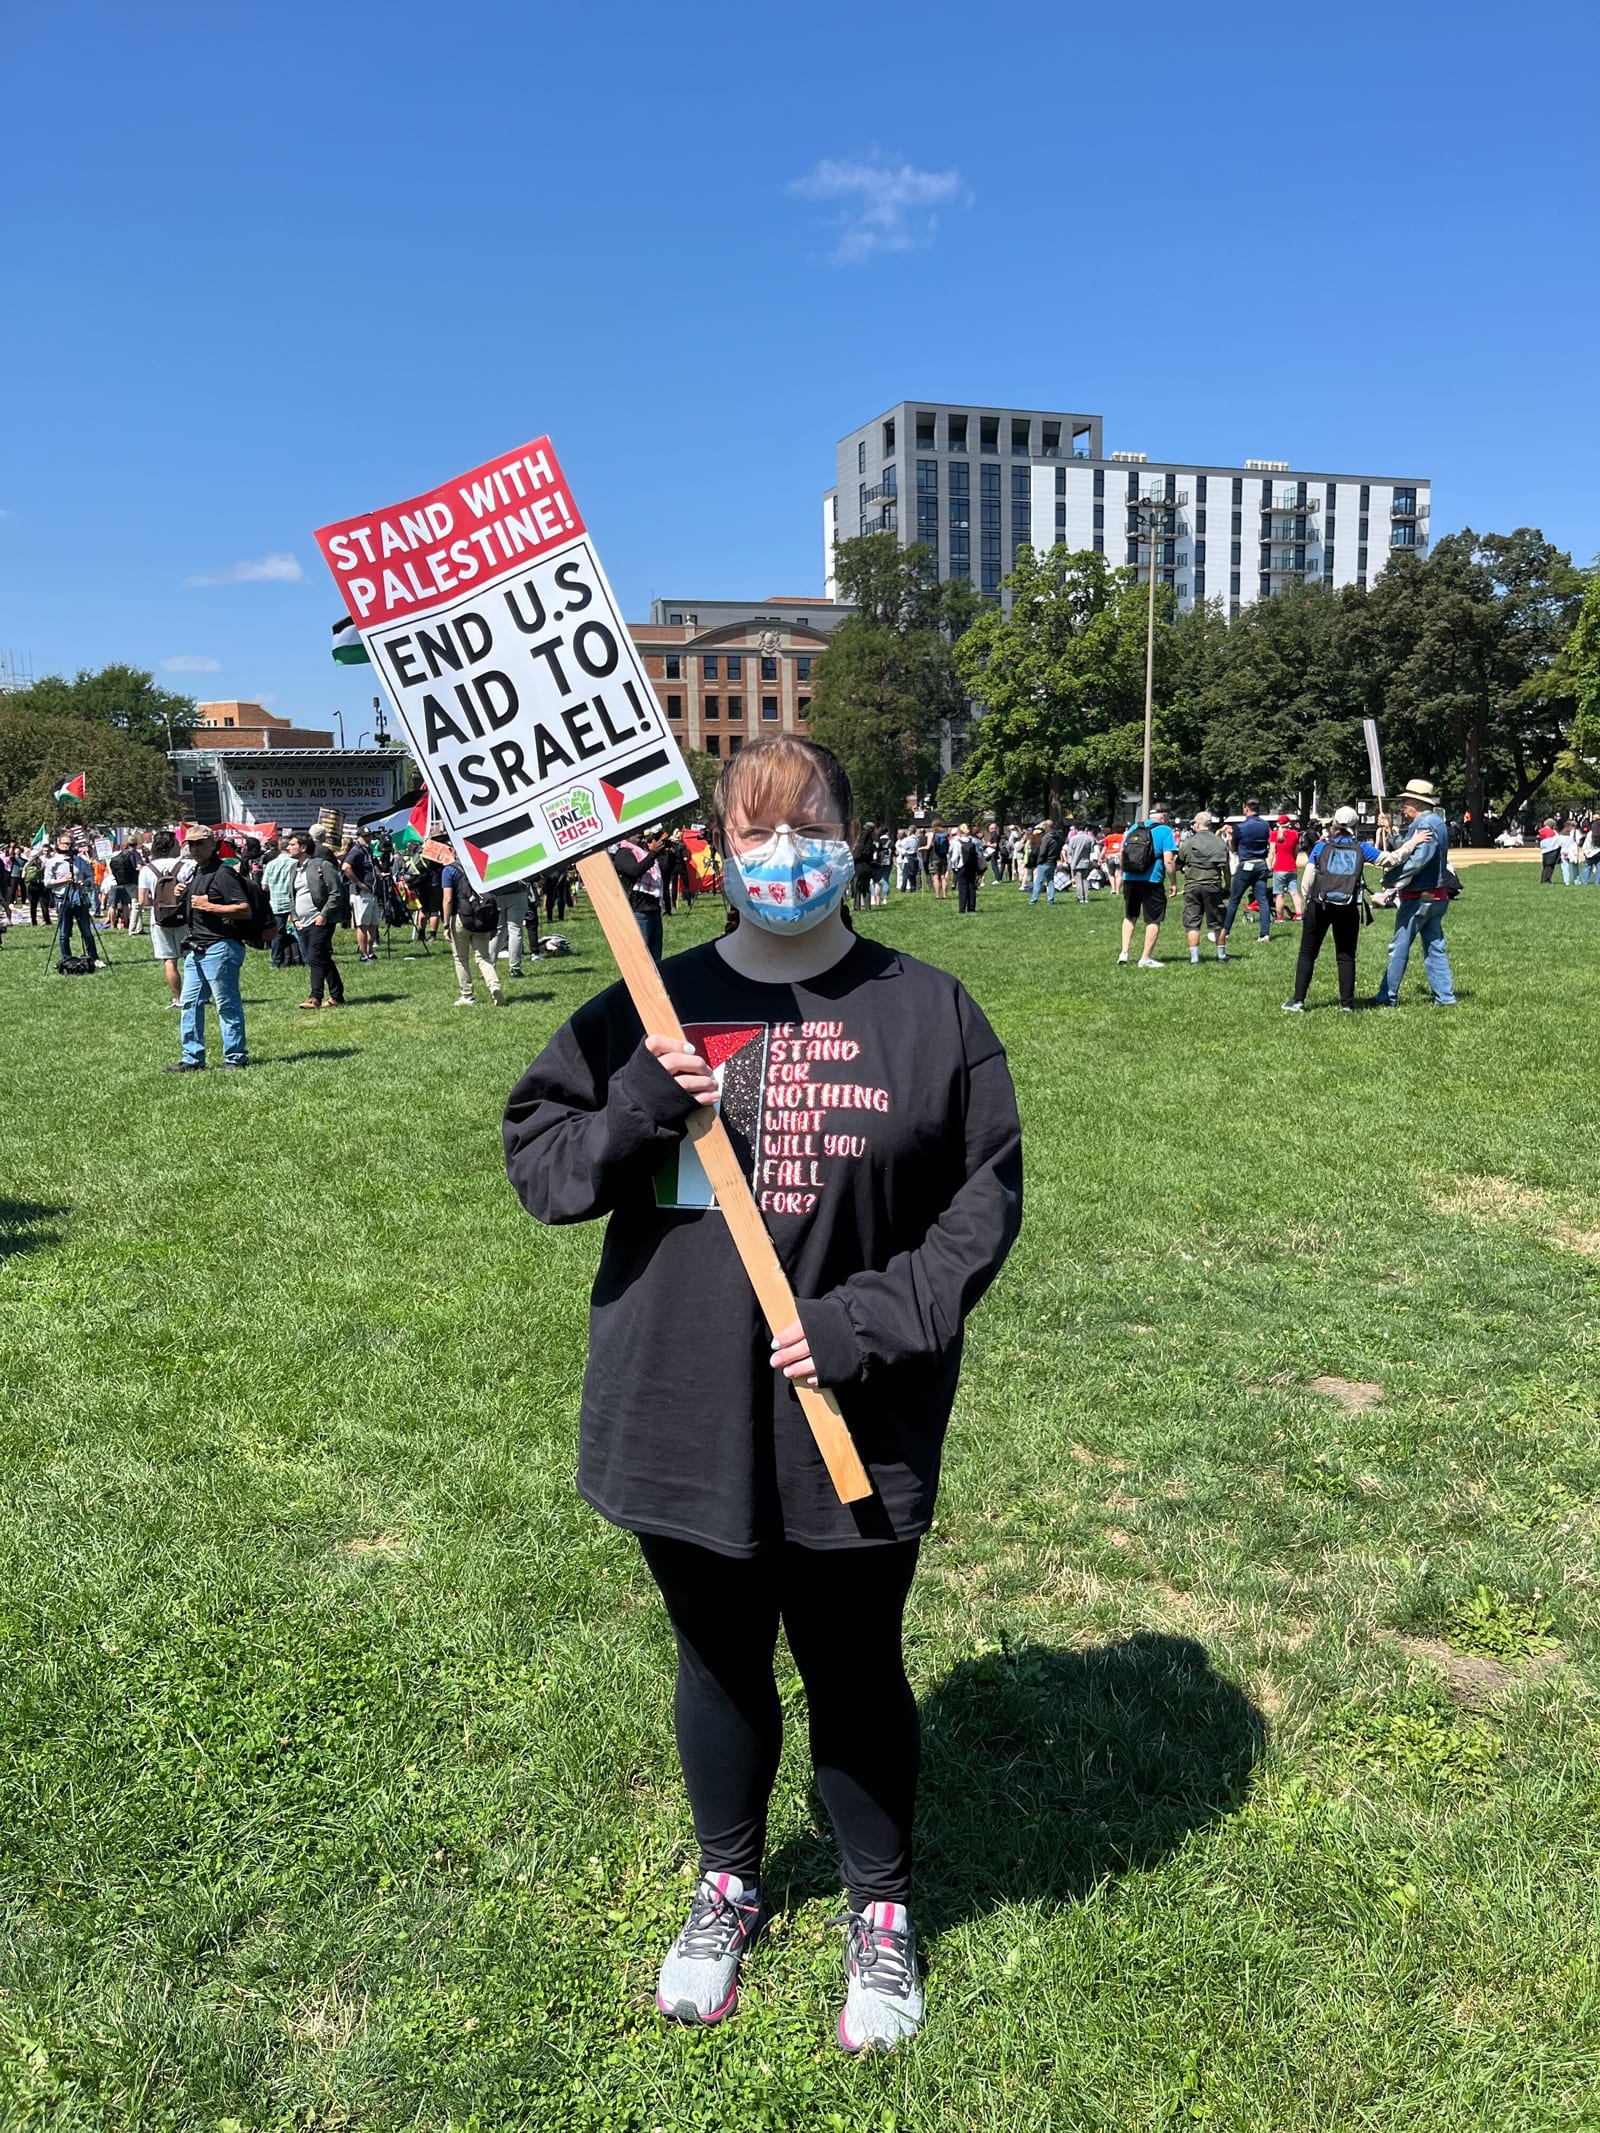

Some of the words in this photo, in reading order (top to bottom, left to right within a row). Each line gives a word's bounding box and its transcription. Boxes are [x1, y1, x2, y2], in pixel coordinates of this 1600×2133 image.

[329, 503, 454, 570] STAND
[459, 450, 554, 519] WITH
[348, 491, 575, 618] PALESTINE!
[384, 612, 493, 688] END
[503, 562, 593, 635] U.S
[422, 670, 519, 754] AID
[530, 620, 619, 696] TO
[439, 681, 652, 815] ISRAEL!
[262, 777, 296, 788] STAND
[301, 777, 326, 787] WITH
[329, 776, 385, 787] PALESTINE!
[262, 788, 282, 799] END
[287, 788, 306, 798] U.S.
[309, 788, 326, 798] AID
[331, 788, 344, 798] TO
[347, 787, 386, 798] ISRAEL!
[551, 807, 583, 831] DNC
[556, 816, 599, 845] 2024
[772, 1021, 795, 1039] IF
[801, 1020, 844, 1038] YOU
[769, 1039, 861, 1063] STAND
[766, 1061, 811, 1084] FOR
[765, 1082, 890, 1114] NOTHING
[764, 1109, 827, 1133] WHAT
[763, 1134, 819, 1158] WILL
[823, 1134, 866, 1158] YOU
[762, 1159, 826, 1188] FALL
[759, 1190, 817, 1215] FOR?
